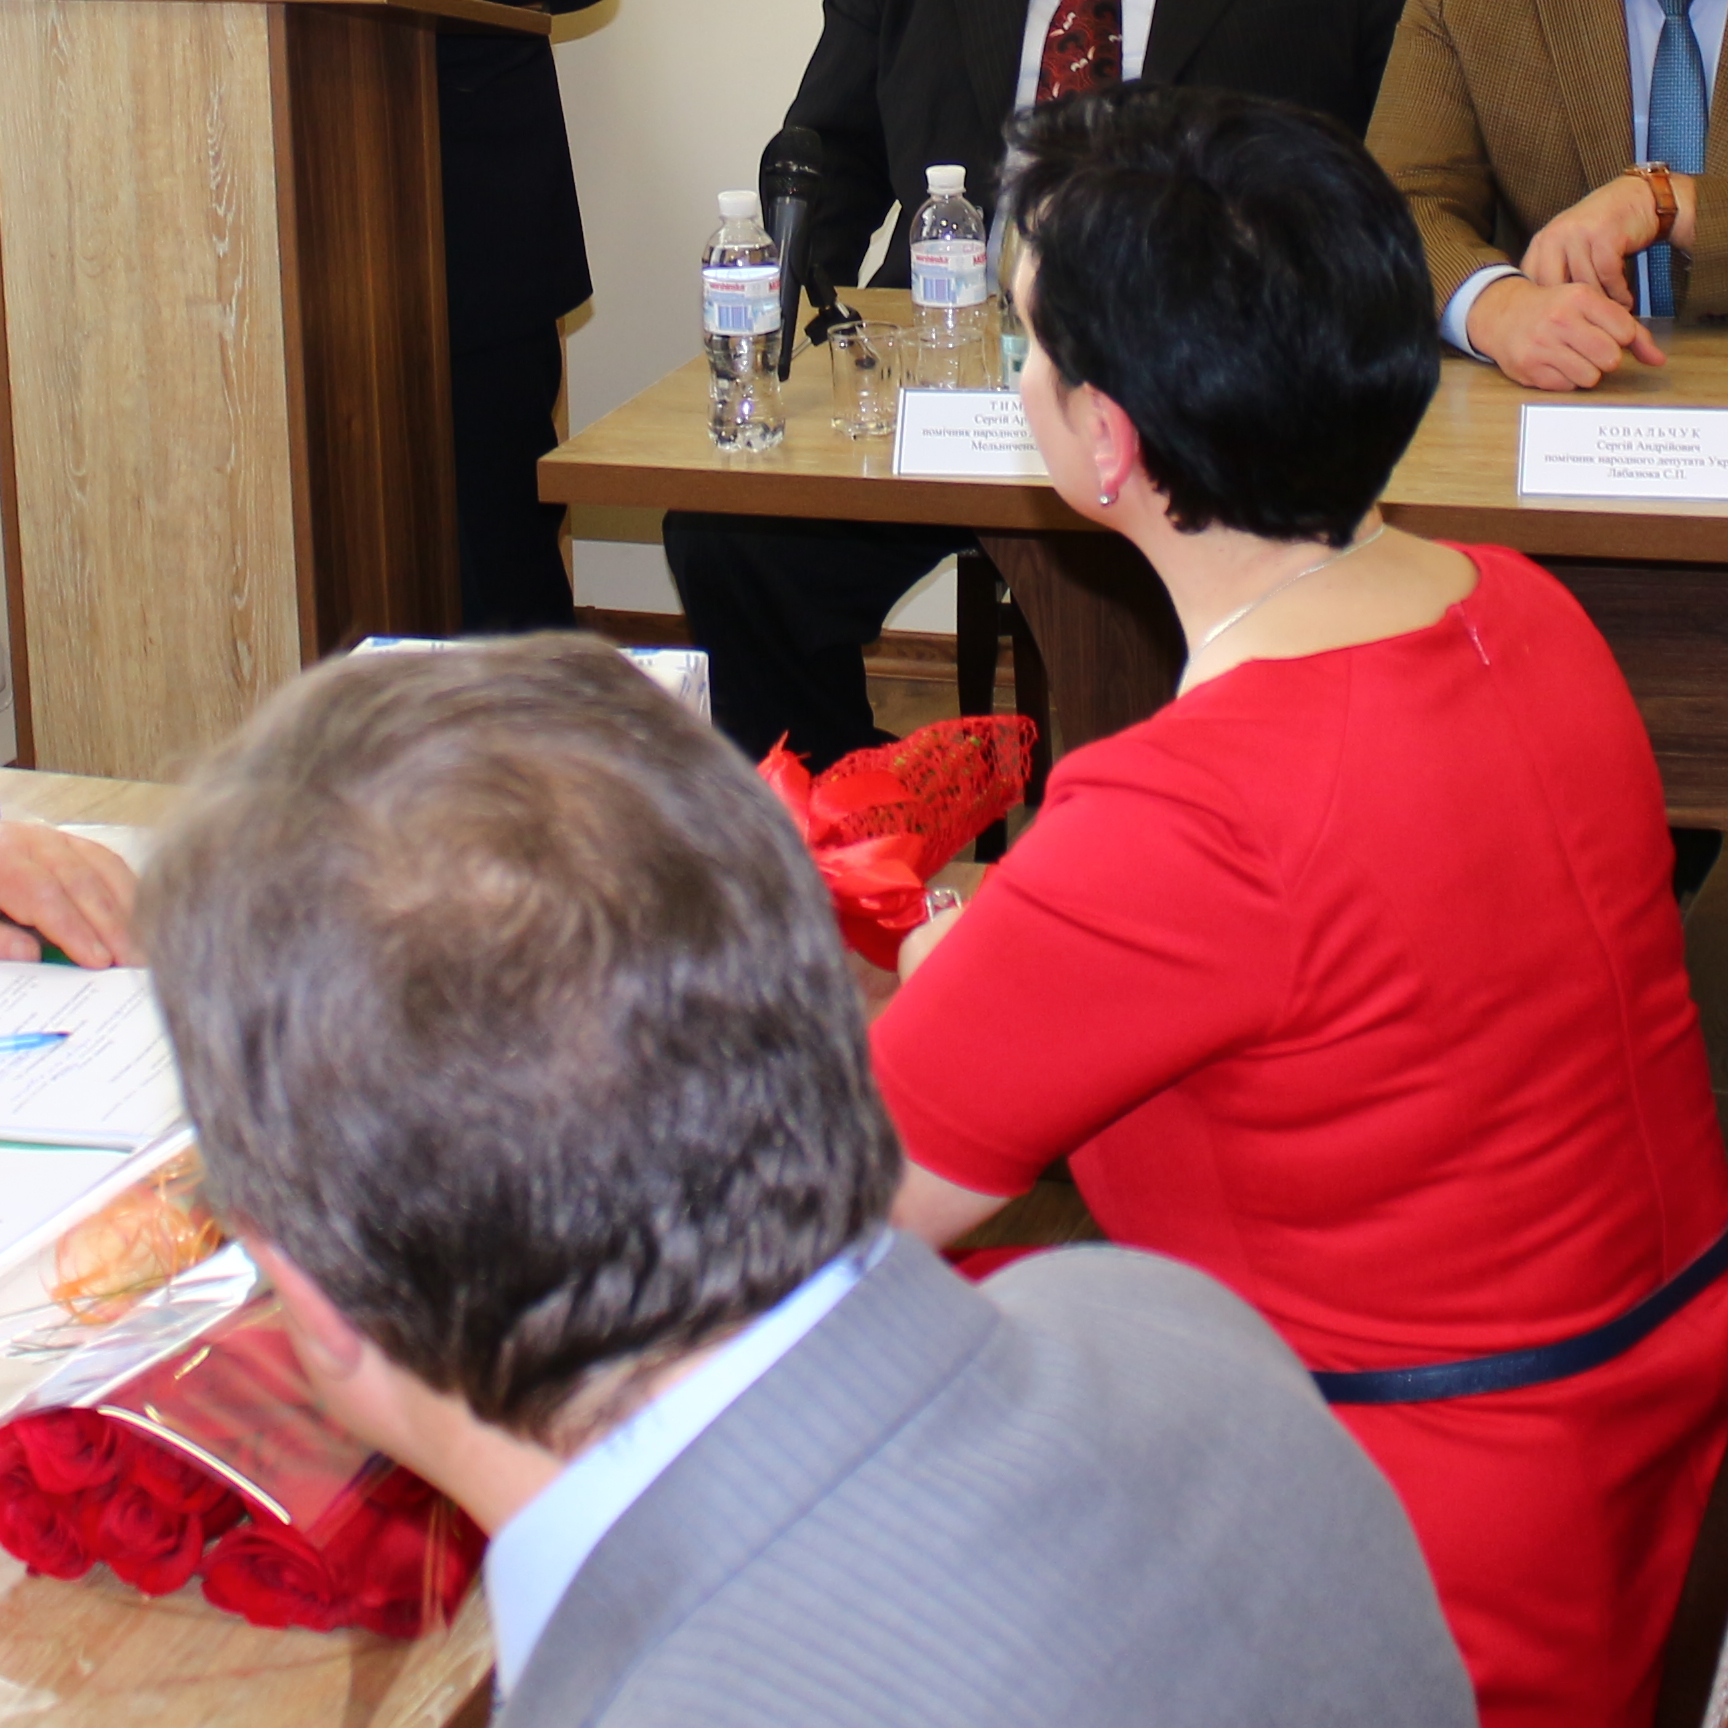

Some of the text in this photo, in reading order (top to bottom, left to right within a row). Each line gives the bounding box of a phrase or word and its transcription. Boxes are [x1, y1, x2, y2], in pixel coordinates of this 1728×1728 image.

[974, 414, 1009, 426] Сергій
[922, 427, 971, 438] помічник
[973, 428, 1028, 440] народного
[1598, 426, 1701, 439] КОВАЛЬЧУК
[1597, 440, 1701, 454] Сергій Андрійович
[1544, 453, 1595, 464] помічник
[1598, 454, 1655, 466] народного
[1657, 456, 1705, 468] депутата
